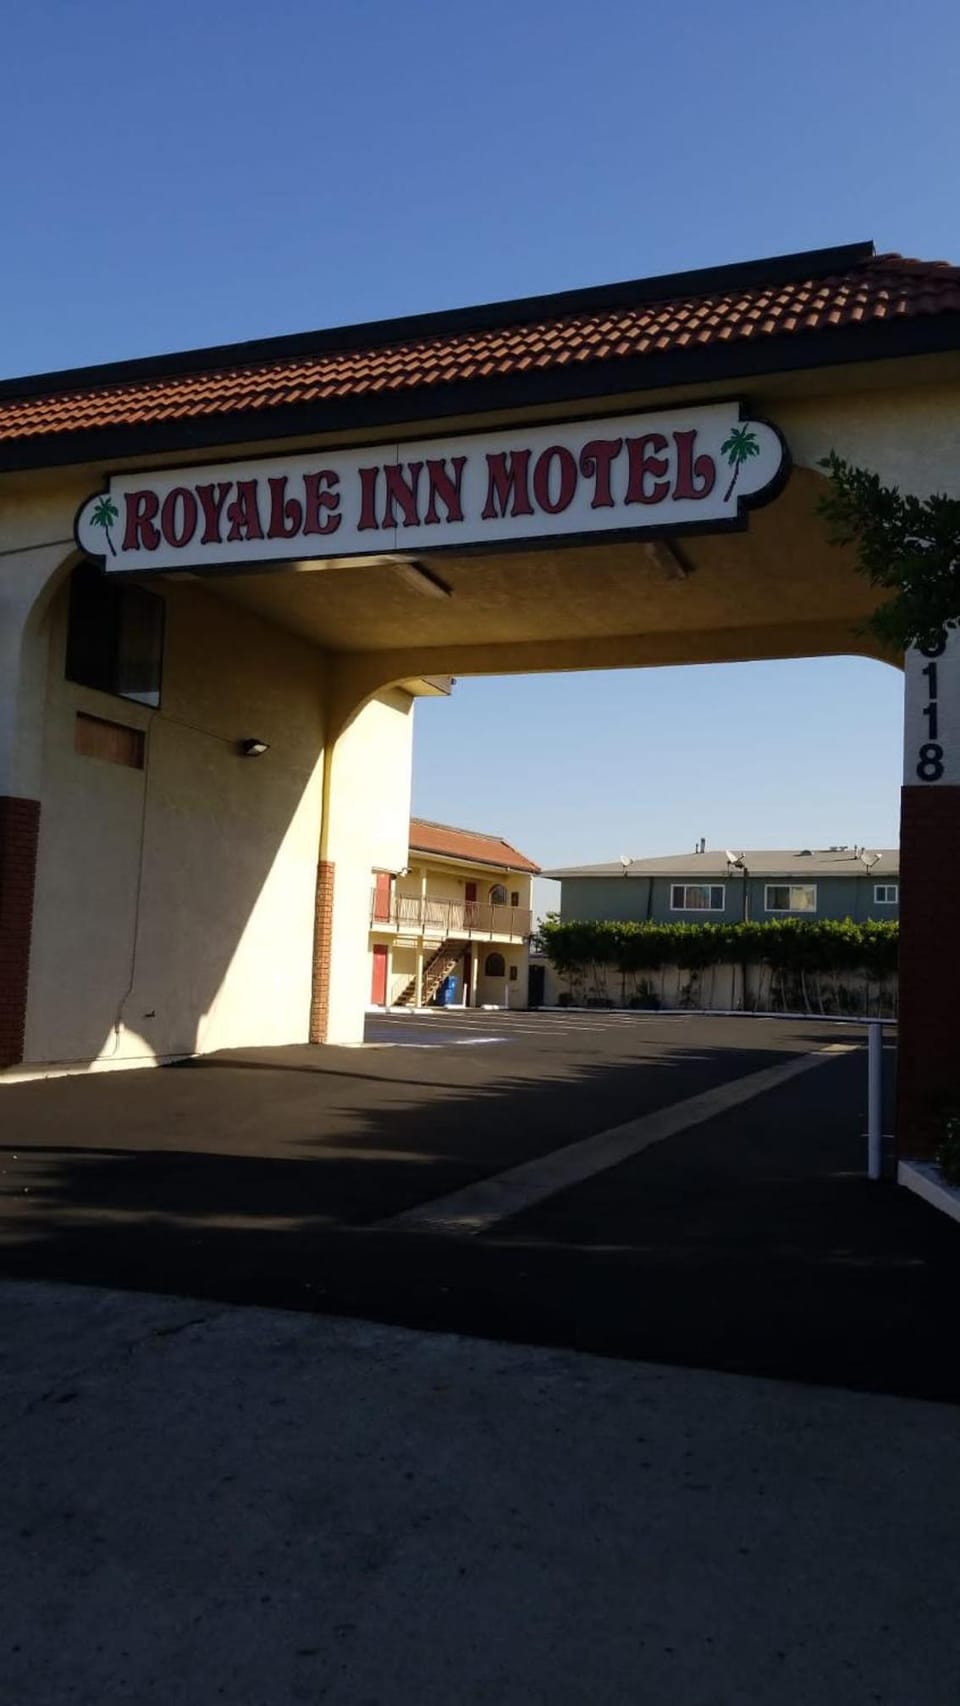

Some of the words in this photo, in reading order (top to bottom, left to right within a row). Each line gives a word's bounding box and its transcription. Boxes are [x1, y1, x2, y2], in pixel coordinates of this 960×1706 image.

[122, 470, 342, 551] ROYALE
[357, 456, 468, 531] INN
[481, 429, 717, 515] MOTEL
